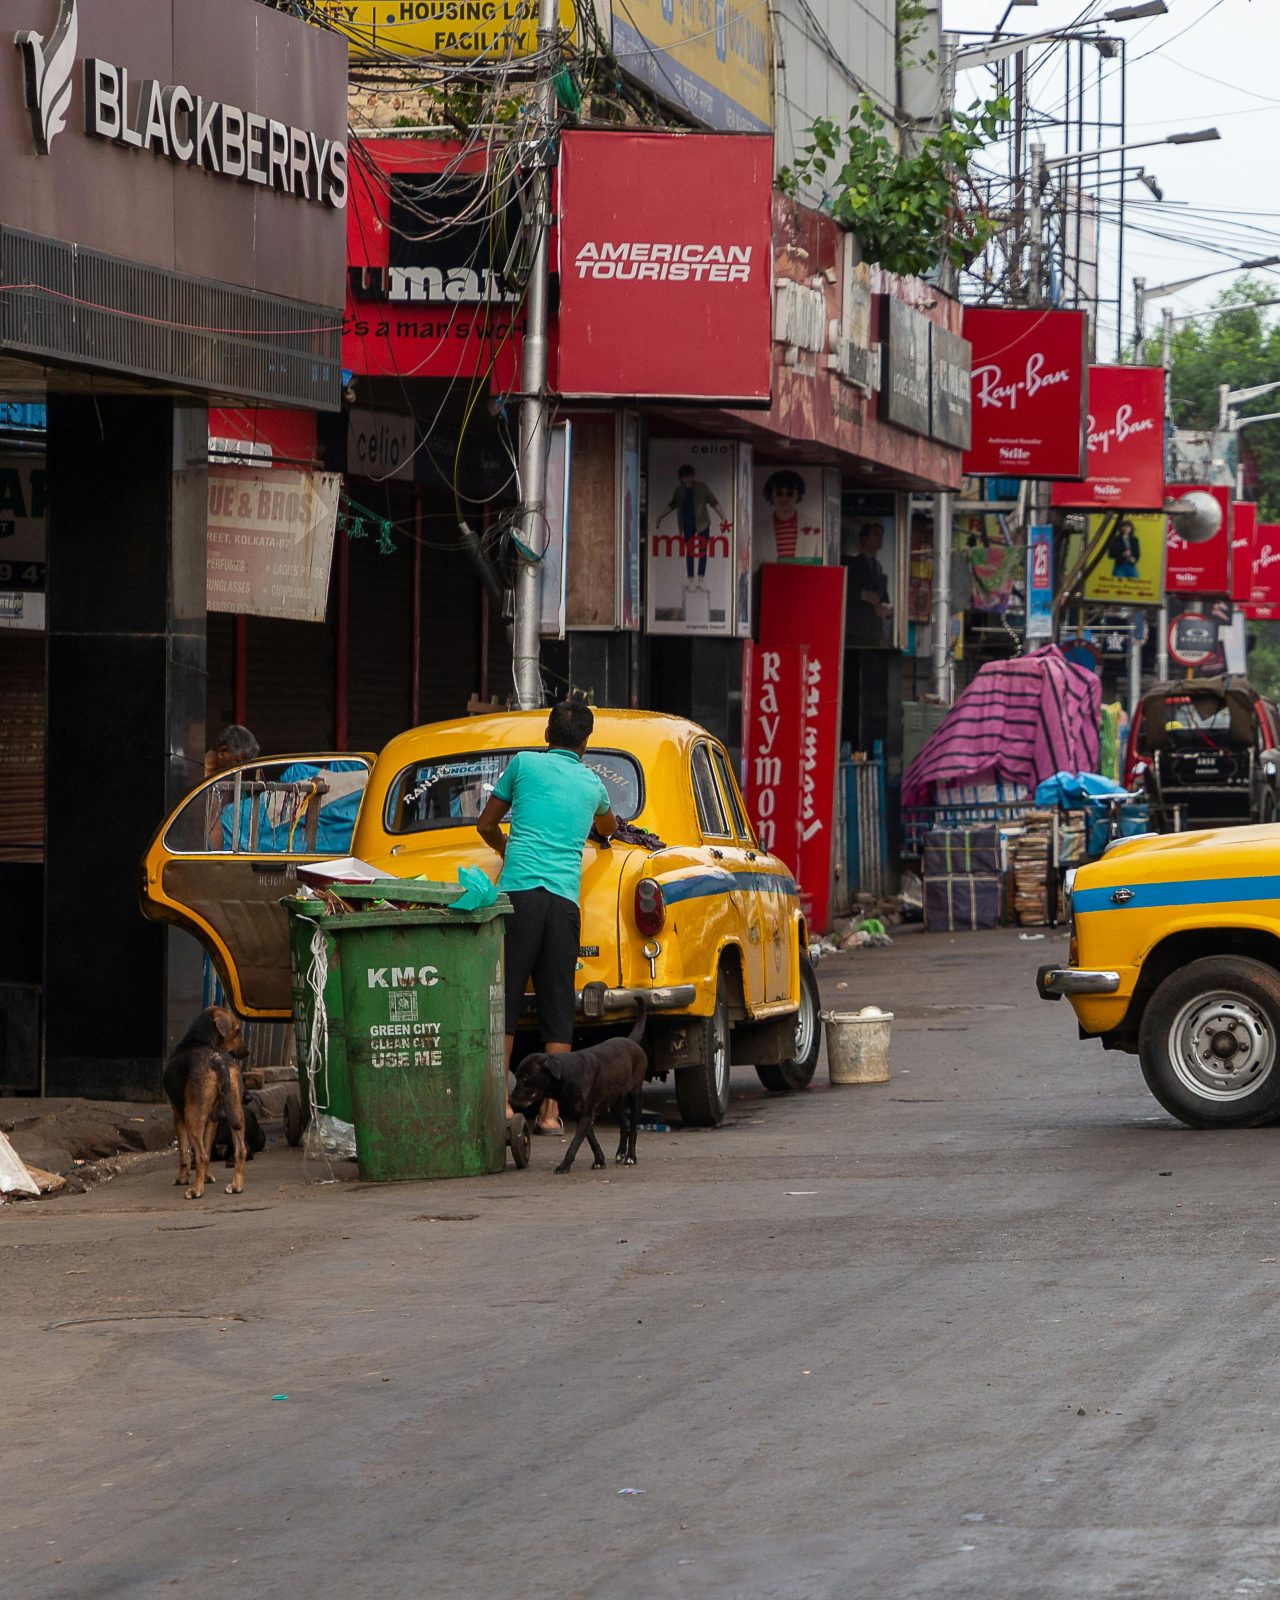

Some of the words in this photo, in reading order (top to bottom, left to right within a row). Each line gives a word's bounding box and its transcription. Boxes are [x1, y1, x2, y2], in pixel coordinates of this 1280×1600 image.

[400, 2, 496, 21] HOUSING
[503, 2, 539, 20] LOA
[434, 32, 527, 51] FACILITY
[90, 57, 348, 209] BLACKBERRYS
[575, 242, 753, 264] AMERICAN
[574, 261, 751, 282] TOURISTER
[396, 319, 470, 339] man's
[971, 352, 1070, 410] Ray-Ban
[209, 485, 236, 517] UE
[238, 493, 253, 519] &
[256, 490, 313, 524] BROS
[652, 533, 730, 559] men
[754, 651, 782, 850] Raymon
[367, 965, 440, 988] KMC
[369, 1023, 411, 1037] GREEN
[412, 1022, 441, 1035] CITY
[370, 1037, 411, 1051] CLEAN
[412, 1036, 441, 1049] CITY
[370, 1051, 411, 1069] USE
[414, 1050, 443, 1067] ME
